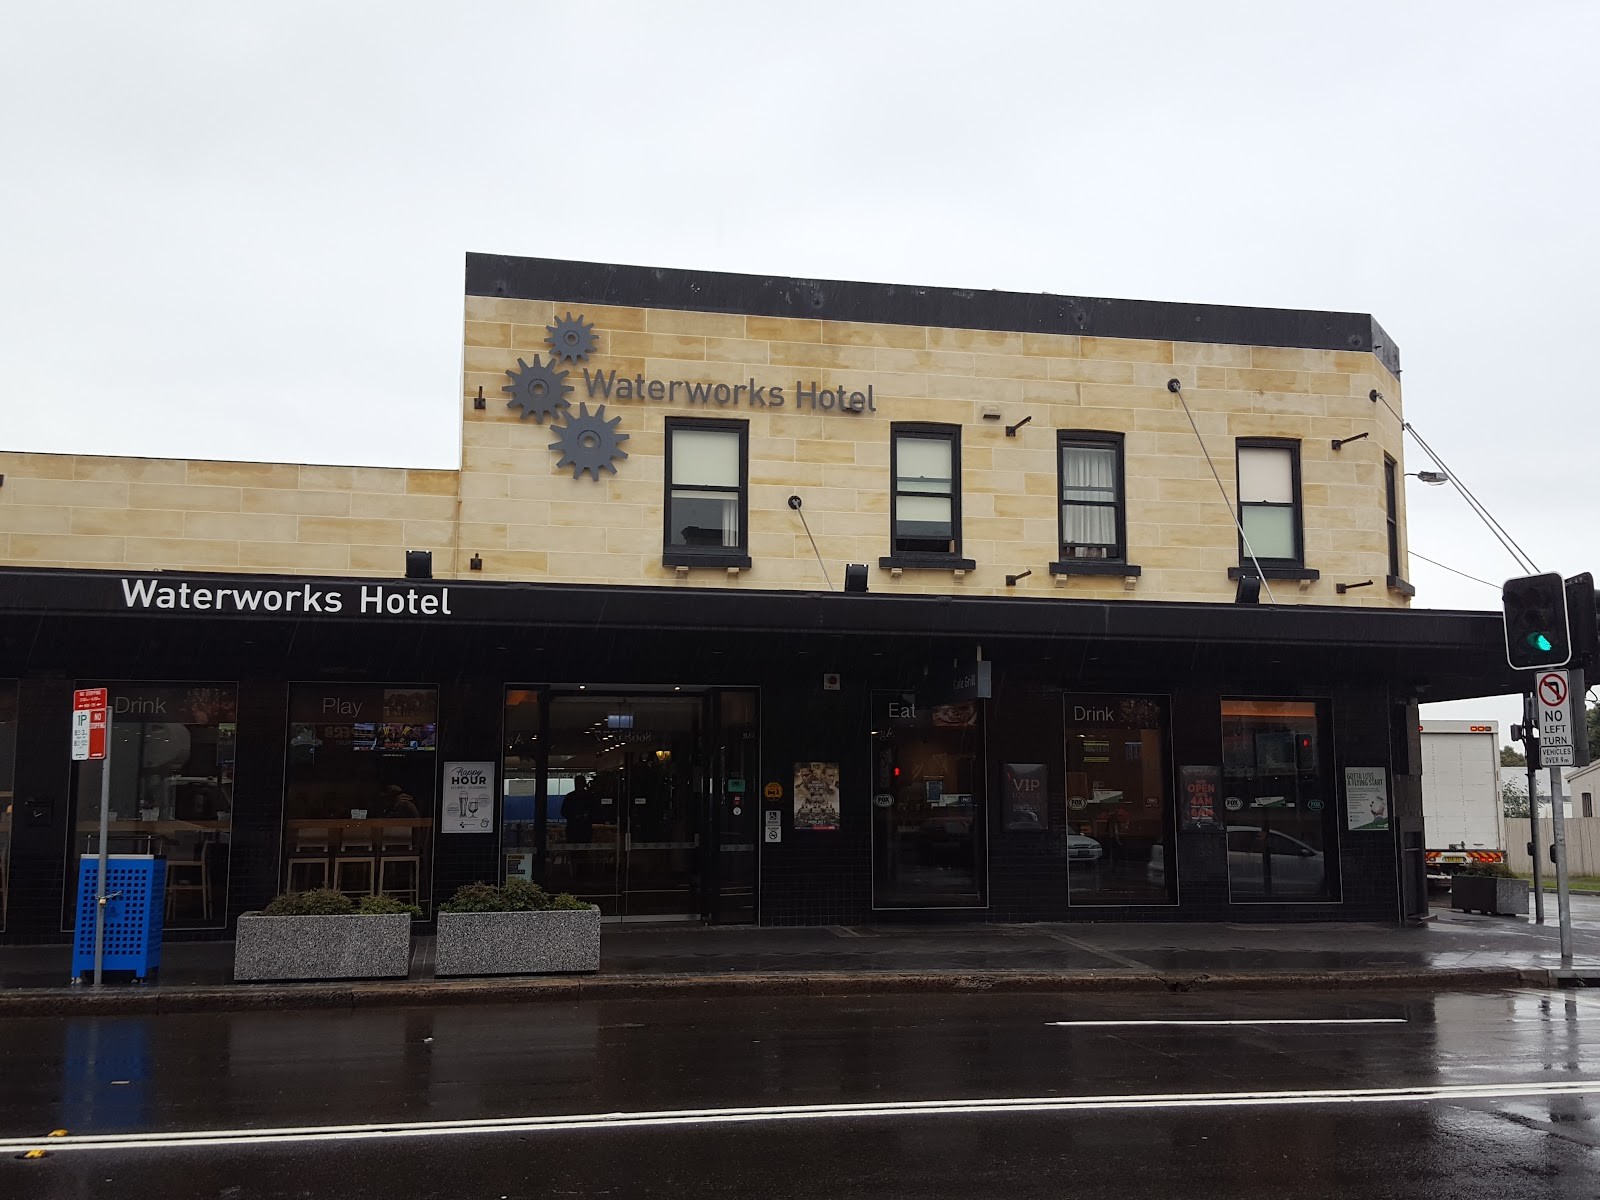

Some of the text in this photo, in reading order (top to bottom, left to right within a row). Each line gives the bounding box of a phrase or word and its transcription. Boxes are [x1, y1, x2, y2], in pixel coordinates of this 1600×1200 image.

[583, 368, 877, 413] Waterworks Hotel
[121, 579, 451, 615] Waterworks Hotel
[114, 697, 167, 714] Drink
[322, 697, 364, 718] Play
[888, 703, 917, 718] Eat
[94, 713, 101, 721] NO
[1074, 706, 1115, 721] Drink
[1545, 710, 1562, 722] NO
[78, 714, 87, 727] 1P
[1544, 724, 1566, 734] LEFT
[1543, 736, 1567, 745] TURN
[1542, 748, 1571, 756] VEHICLES
[451, 766, 483, 778] Happy
[1347, 772, 1362, 780] GOTTA
[451, 776, 487, 785] HOUR
[1013, 779, 1040, 791] VIP
[1187, 784, 1215, 792] OPEN
